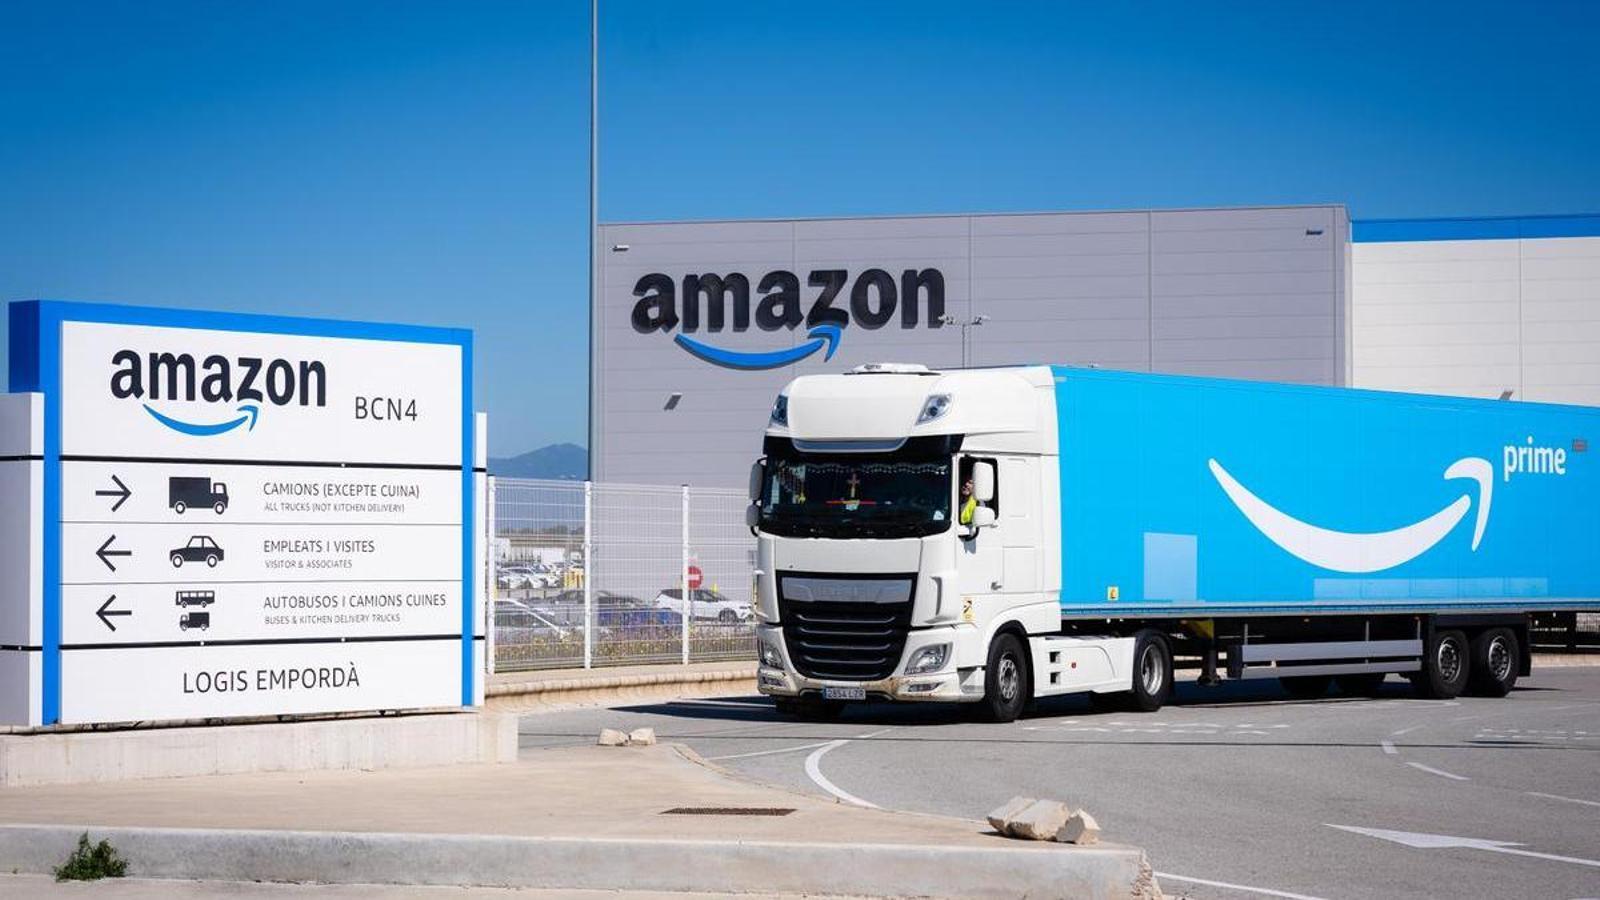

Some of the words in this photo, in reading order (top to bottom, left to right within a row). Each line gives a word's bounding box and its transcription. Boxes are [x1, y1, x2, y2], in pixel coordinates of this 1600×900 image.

[631, 267, 946, 333] amazon
[110, 349, 327, 407] amazon
[354, 396, 419, 421] BCN4
[1503, 435, 1567, 482] prime
[263, 482, 319, 496] CAMIONS
[323, 483, 377, 498] (EXCEPTE
[380, 484, 420, 499] CUINA)
[264, 502, 278, 512] ALL
[280, 502, 310, 512] TRUCKS
[312, 502, 331, 513] (NOT
[333, 503, 366, 512] KITCHEN
[367, 503, 405, 513] DELIVERY)
[263, 540, 323, 553] EMPLEATS
[326, 541, 330, 552] I
[333, 540, 376, 553] VISITES
[265, 559, 296, 569] VISITOR
[298, 560, 304, 568] &
[306, 559, 353, 569] ASSOCIATES
[263, 595, 338, 609] AUTOBUSOS
[342, 596, 345, 607] I
[349, 594, 402, 608] CAMIONS
[406, 593, 447, 607] CUINES
[264, 615, 290, 625] BUSES
[292, 616, 298, 624] &
[300, 614, 333, 624] KITCHEN
[334, 614, 370, 624] DELIVERY
[372, 613, 401, 622] TRUCKS
[183, 670, 249, 694] LOGIS
[256, 661, 360, 690] EMPORDÀ
